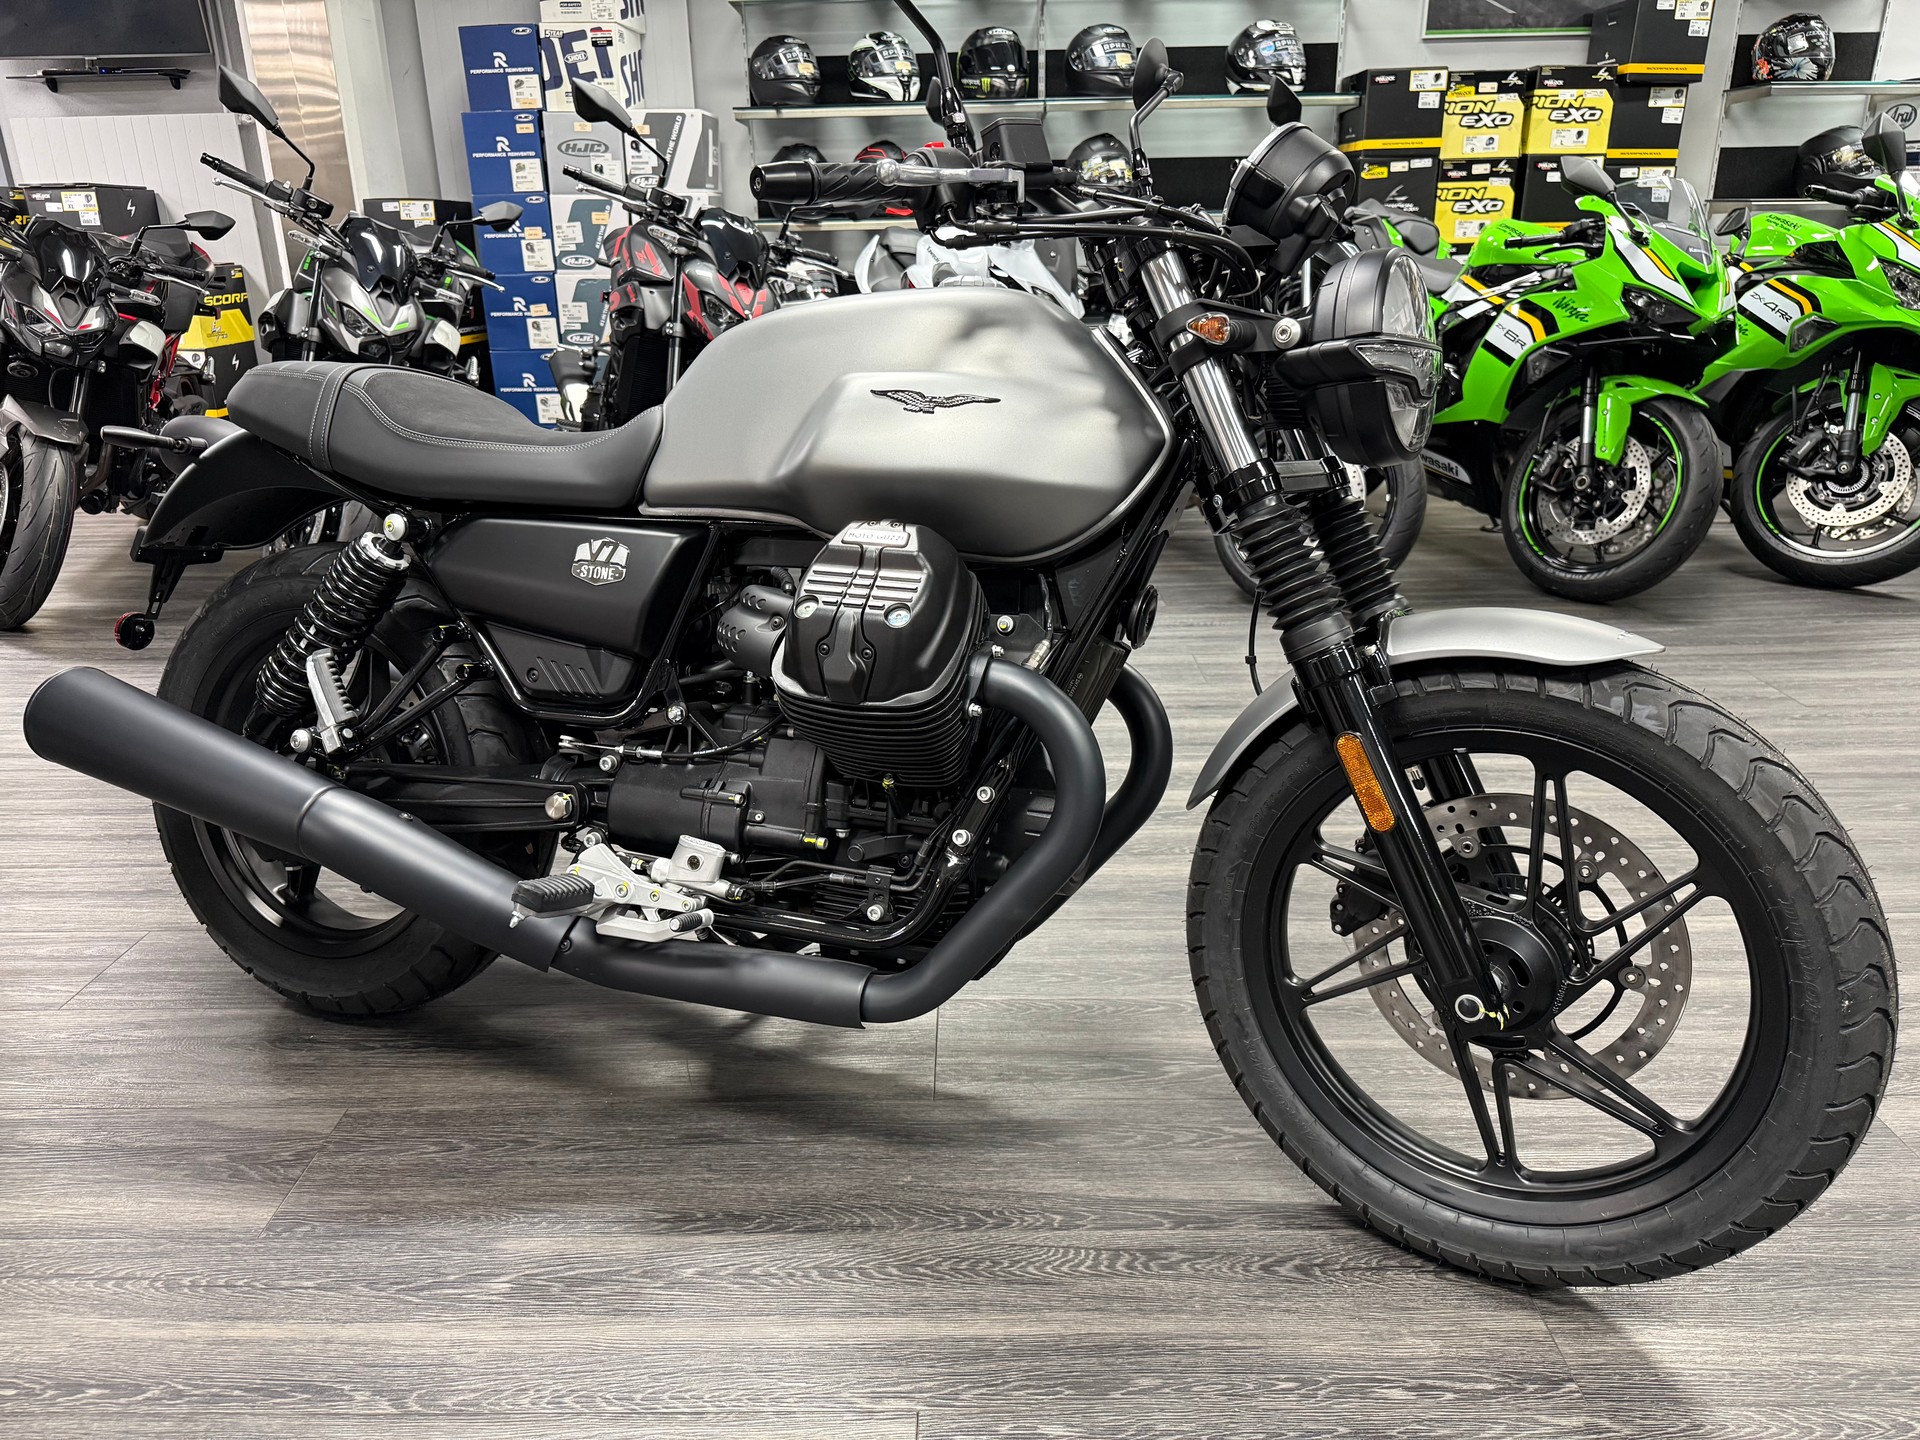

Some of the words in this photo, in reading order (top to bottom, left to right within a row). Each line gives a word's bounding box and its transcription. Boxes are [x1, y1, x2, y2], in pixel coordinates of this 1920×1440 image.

[672, 115, 683, 141] WORLD
[565, 142, 603, 153] HJC
[1552, 296, 1590, 323] Ninja
[1421, 453, 1460, 477] wasaki
[848, 532, 873, 540] MOTO
[876, 533, 905, 542] GUZZI
[589, 537, 620, 563] V7
[579, 565, 617, 581] STONE
